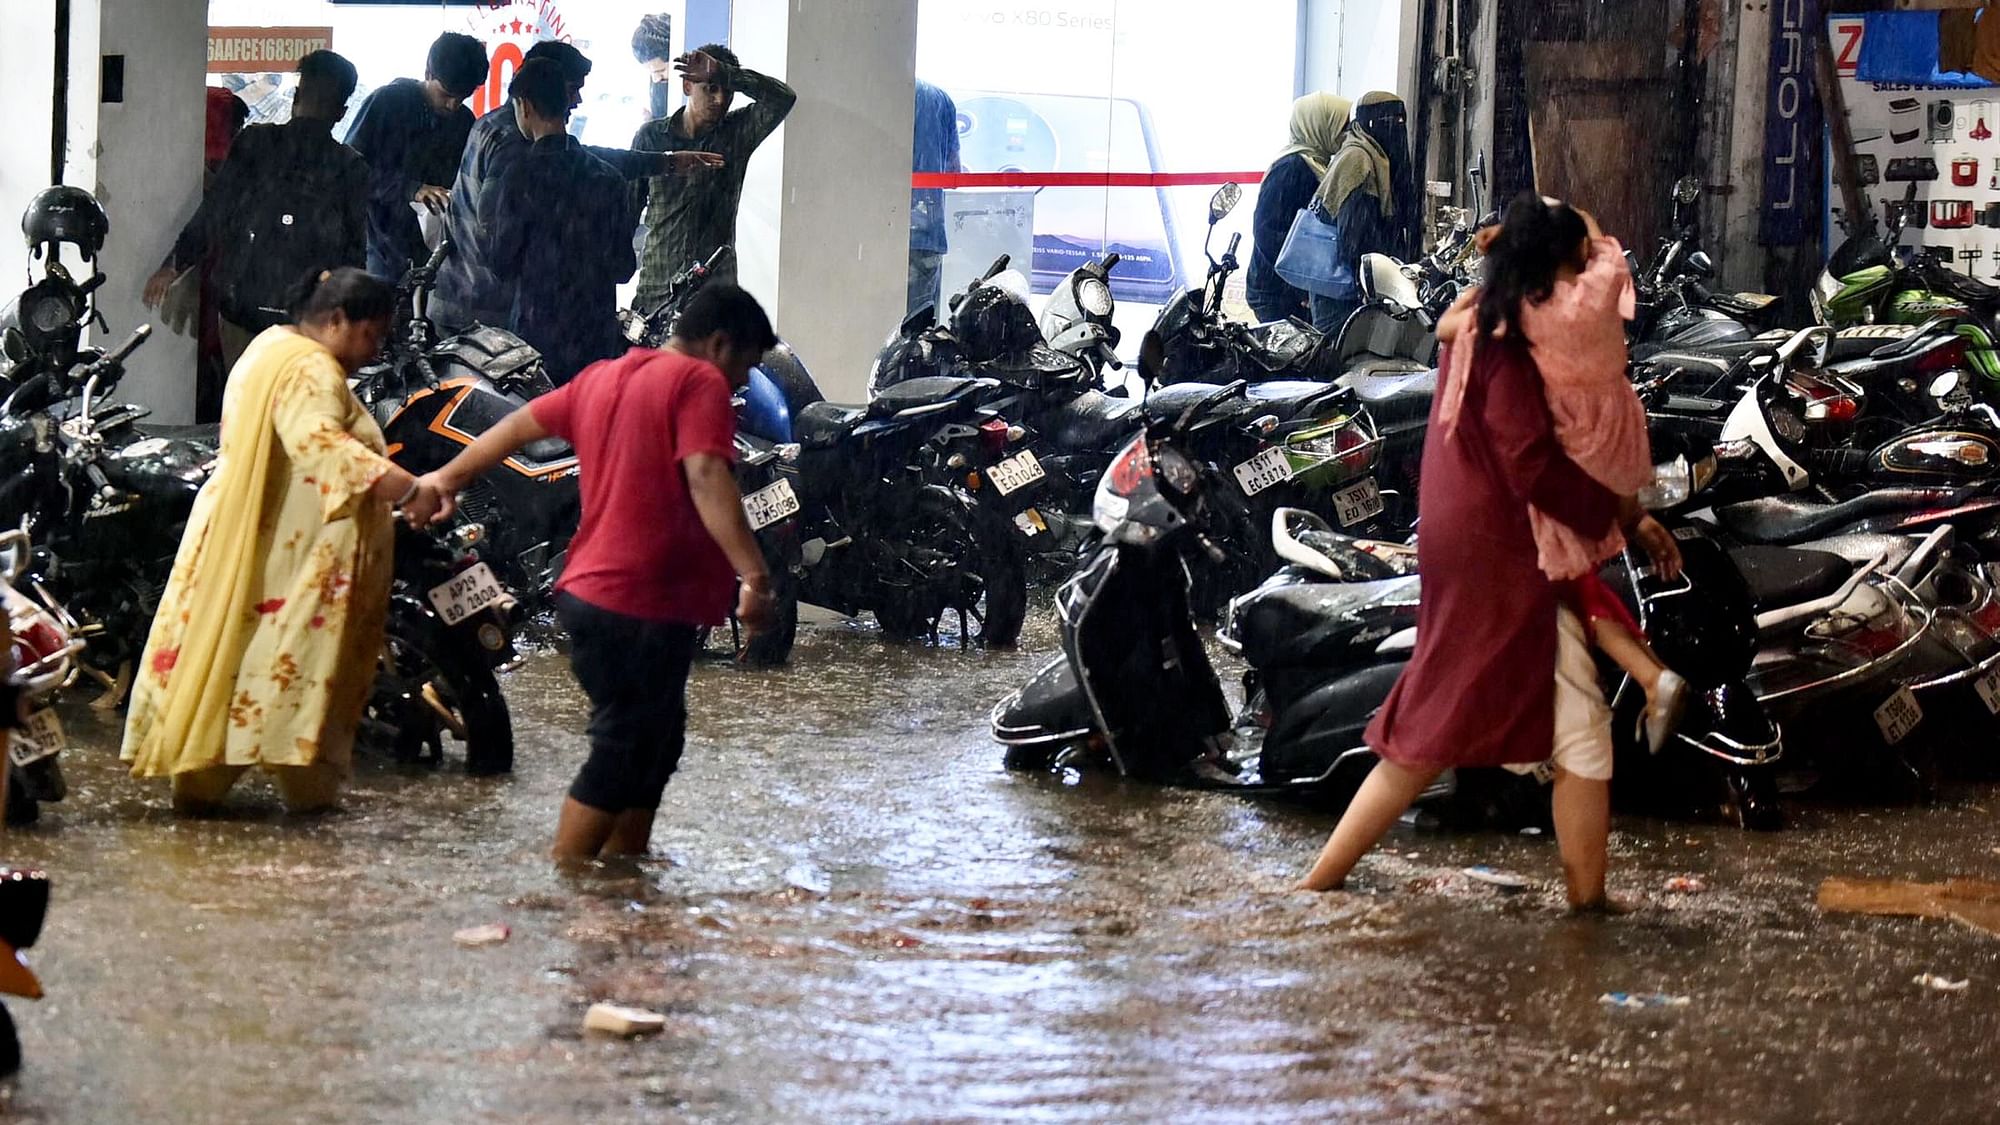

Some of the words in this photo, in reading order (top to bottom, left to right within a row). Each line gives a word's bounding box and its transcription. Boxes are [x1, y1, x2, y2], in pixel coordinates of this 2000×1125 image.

[1056, 11, 1113, 30] Series
[1247, 477, 1263, 493] EC
[1261, 464, 1287, 485] 5878
